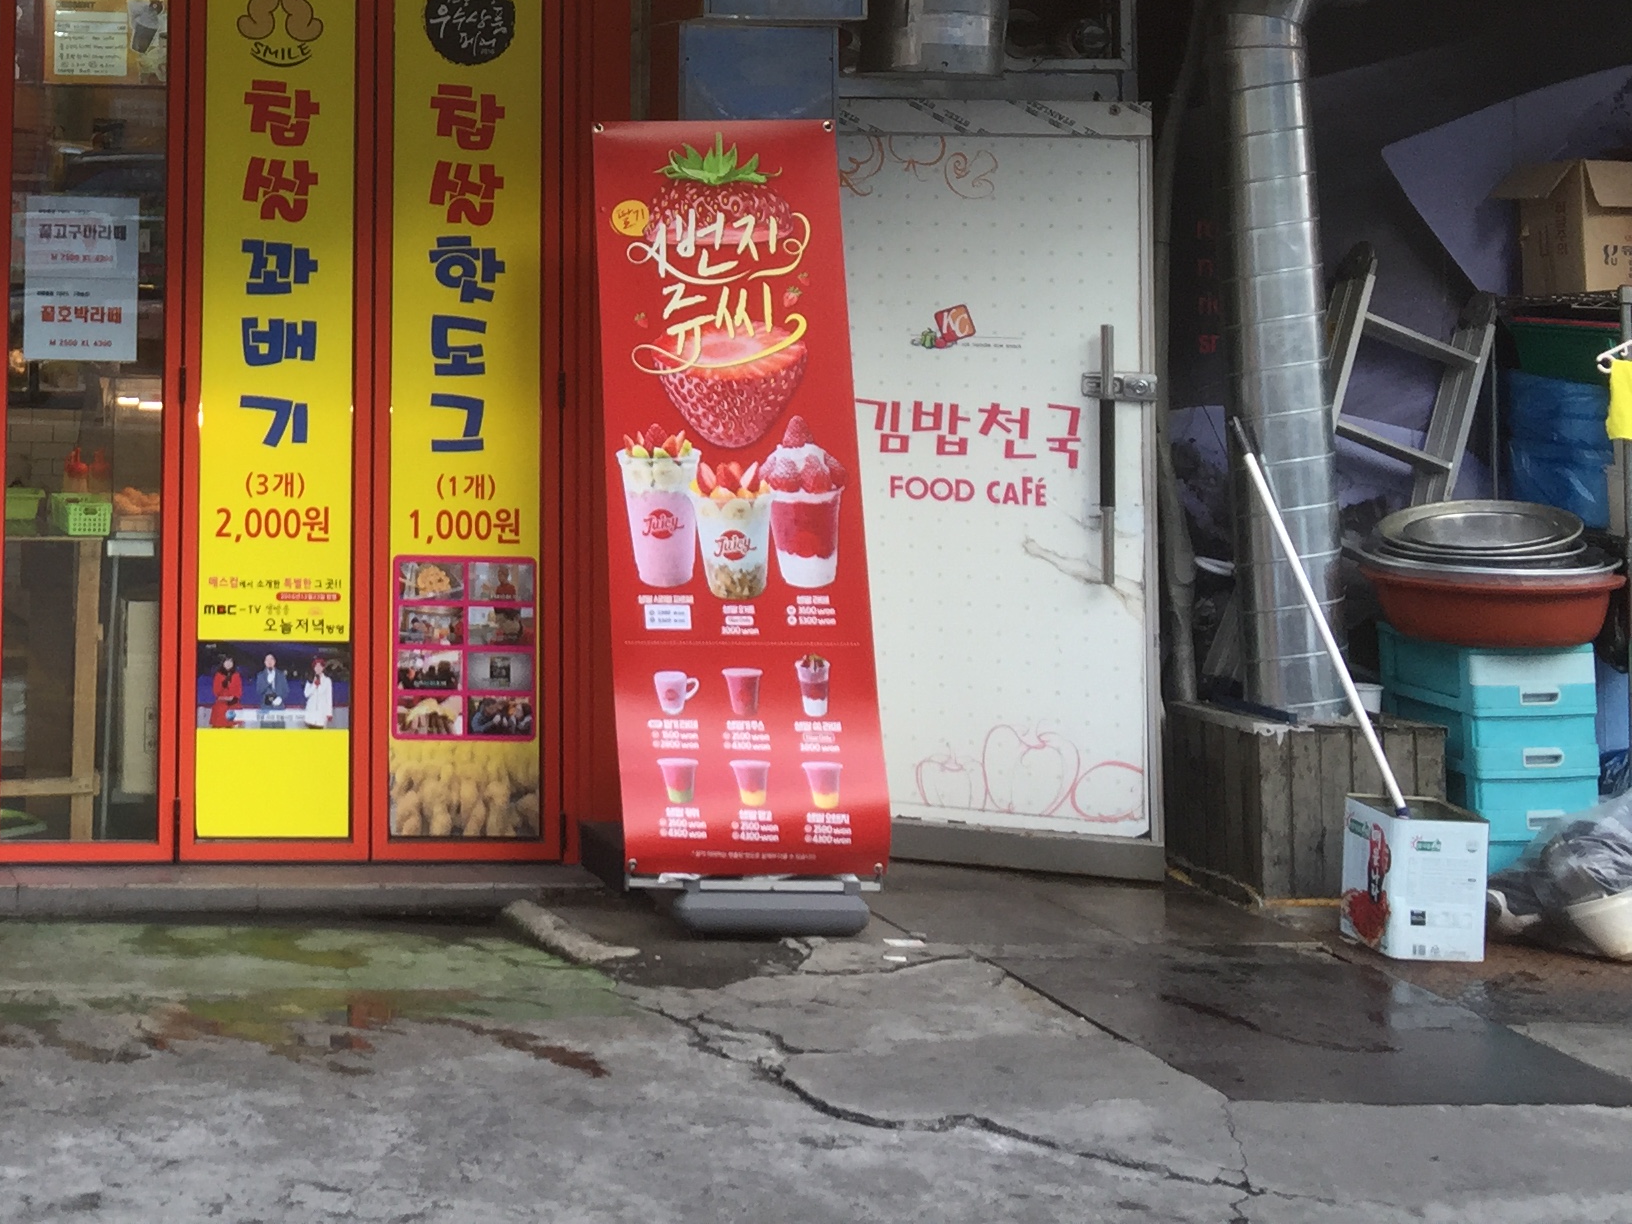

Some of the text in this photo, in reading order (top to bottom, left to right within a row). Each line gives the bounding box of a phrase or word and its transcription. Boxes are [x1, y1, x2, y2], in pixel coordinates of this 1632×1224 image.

[251, 42, 311, 60] SMILE
[942, 308, 970, 338] KC
[855, 398, 1082, 471] 김밥천국
[244, 471, 306, 499] (3개)
[436, 474, 496, 501] (1개)
[889, 476, 976, 502] FOOD
[215, 506, 331, 543] 2,000원
[409, 508, 521, 545] 1,000원
[642, 512, 685, 536] Juicy
[713, 534, 757, 558] Juicy
[204, 604, 237, 615] MBC
